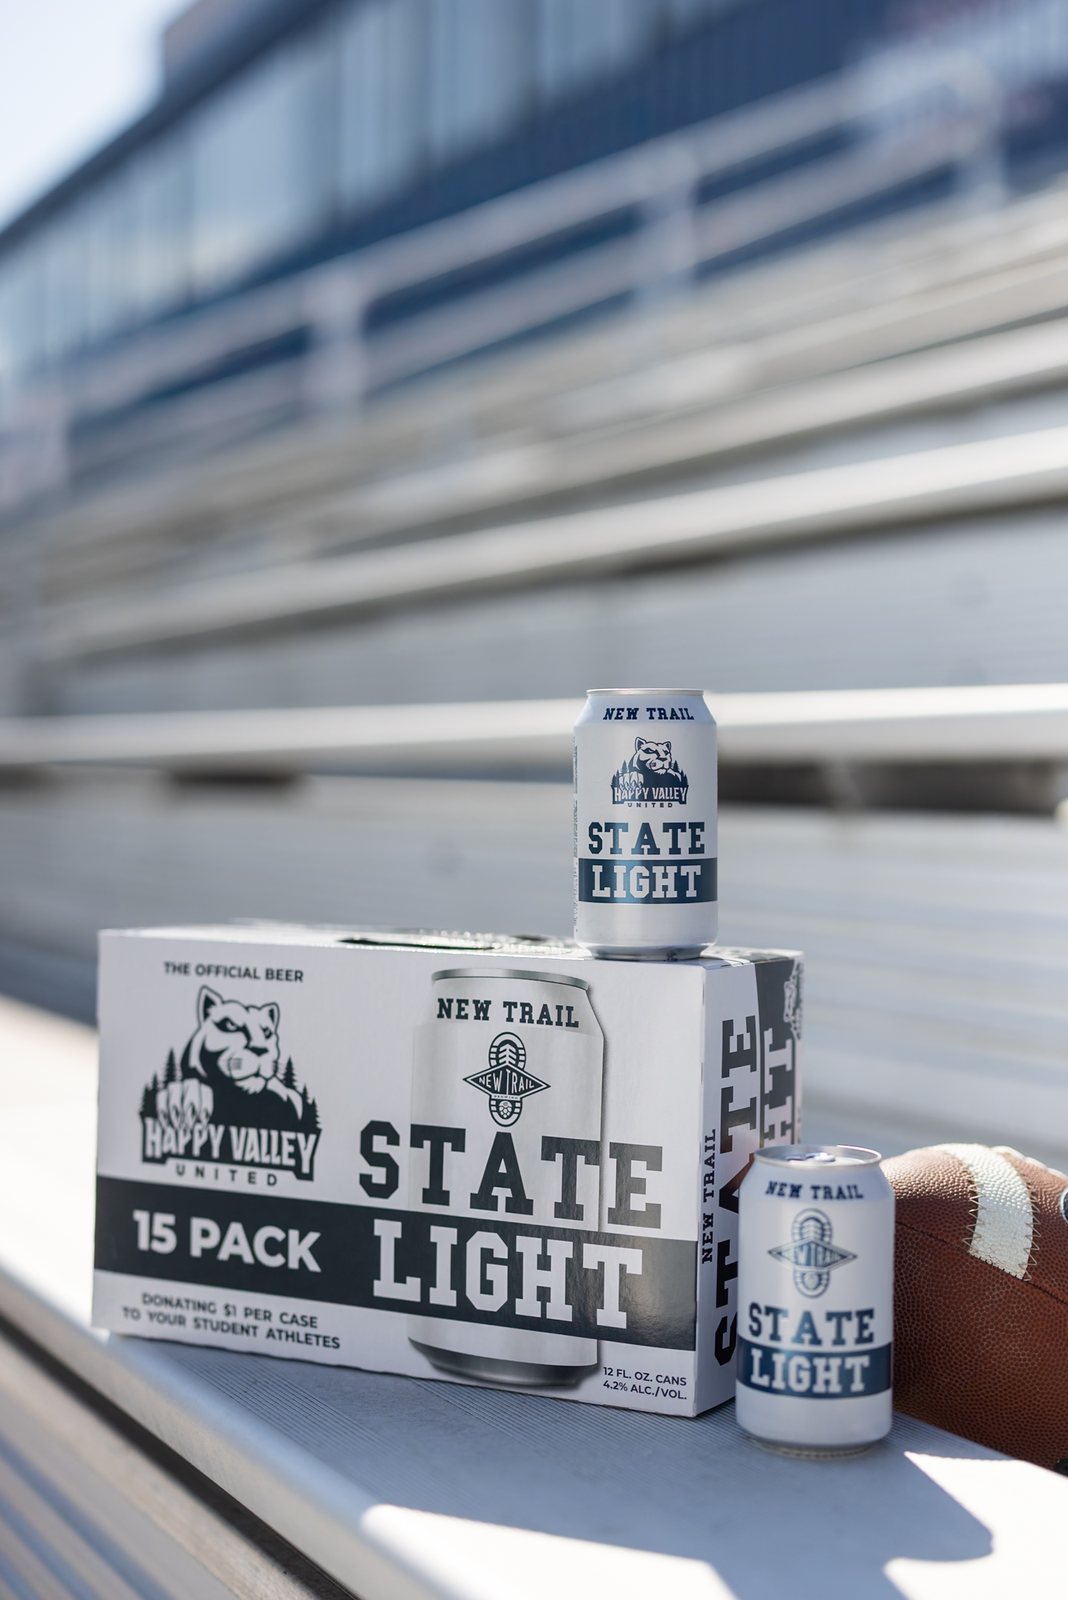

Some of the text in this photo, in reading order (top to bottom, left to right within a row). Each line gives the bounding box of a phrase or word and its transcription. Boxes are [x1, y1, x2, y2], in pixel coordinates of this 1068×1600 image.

[603, 707, 694, 721] NEW TRAIL
[614, 787, 687, 802] HAPPY VALLEY
[588, 822, 705, 855] STATE
[592, 865, 701, 898] LIGHT
[164, 961, 304, 982] THE OFFICIAL BEER
[437, 998, 580, 1028] NEW TRAIL
[479, 1068, 535, 1095] NEW TRAIL
[145, 1116, 317, 1174] HAPPY VALLEY
[176, 1164, 278, 1186] UNITED
[359, 1120, 663, 1229] STATE
[765, 1180, 863, 1200] NEW TRAIL
[702, 1129, 716, 1264] NEW TRAIL
[133, 1209, 322, 1273] 15 PACK
[373, 1218, 643, 1329] LIGHT
[122, 1306, 341, 1349] TO YOUR STUDENT ATHLETES
[142, 1293, 318, 1329] DONATING $1 PER CASE
[748, 1302, 875, 1346] STATE
[603, 1366, 687, 1386] 12 FL. OZ. CANS
[751, 1349, 870, 1393] LIGHT
[603, 1380, 687, 1400] 4.2% ALC./VOL.
